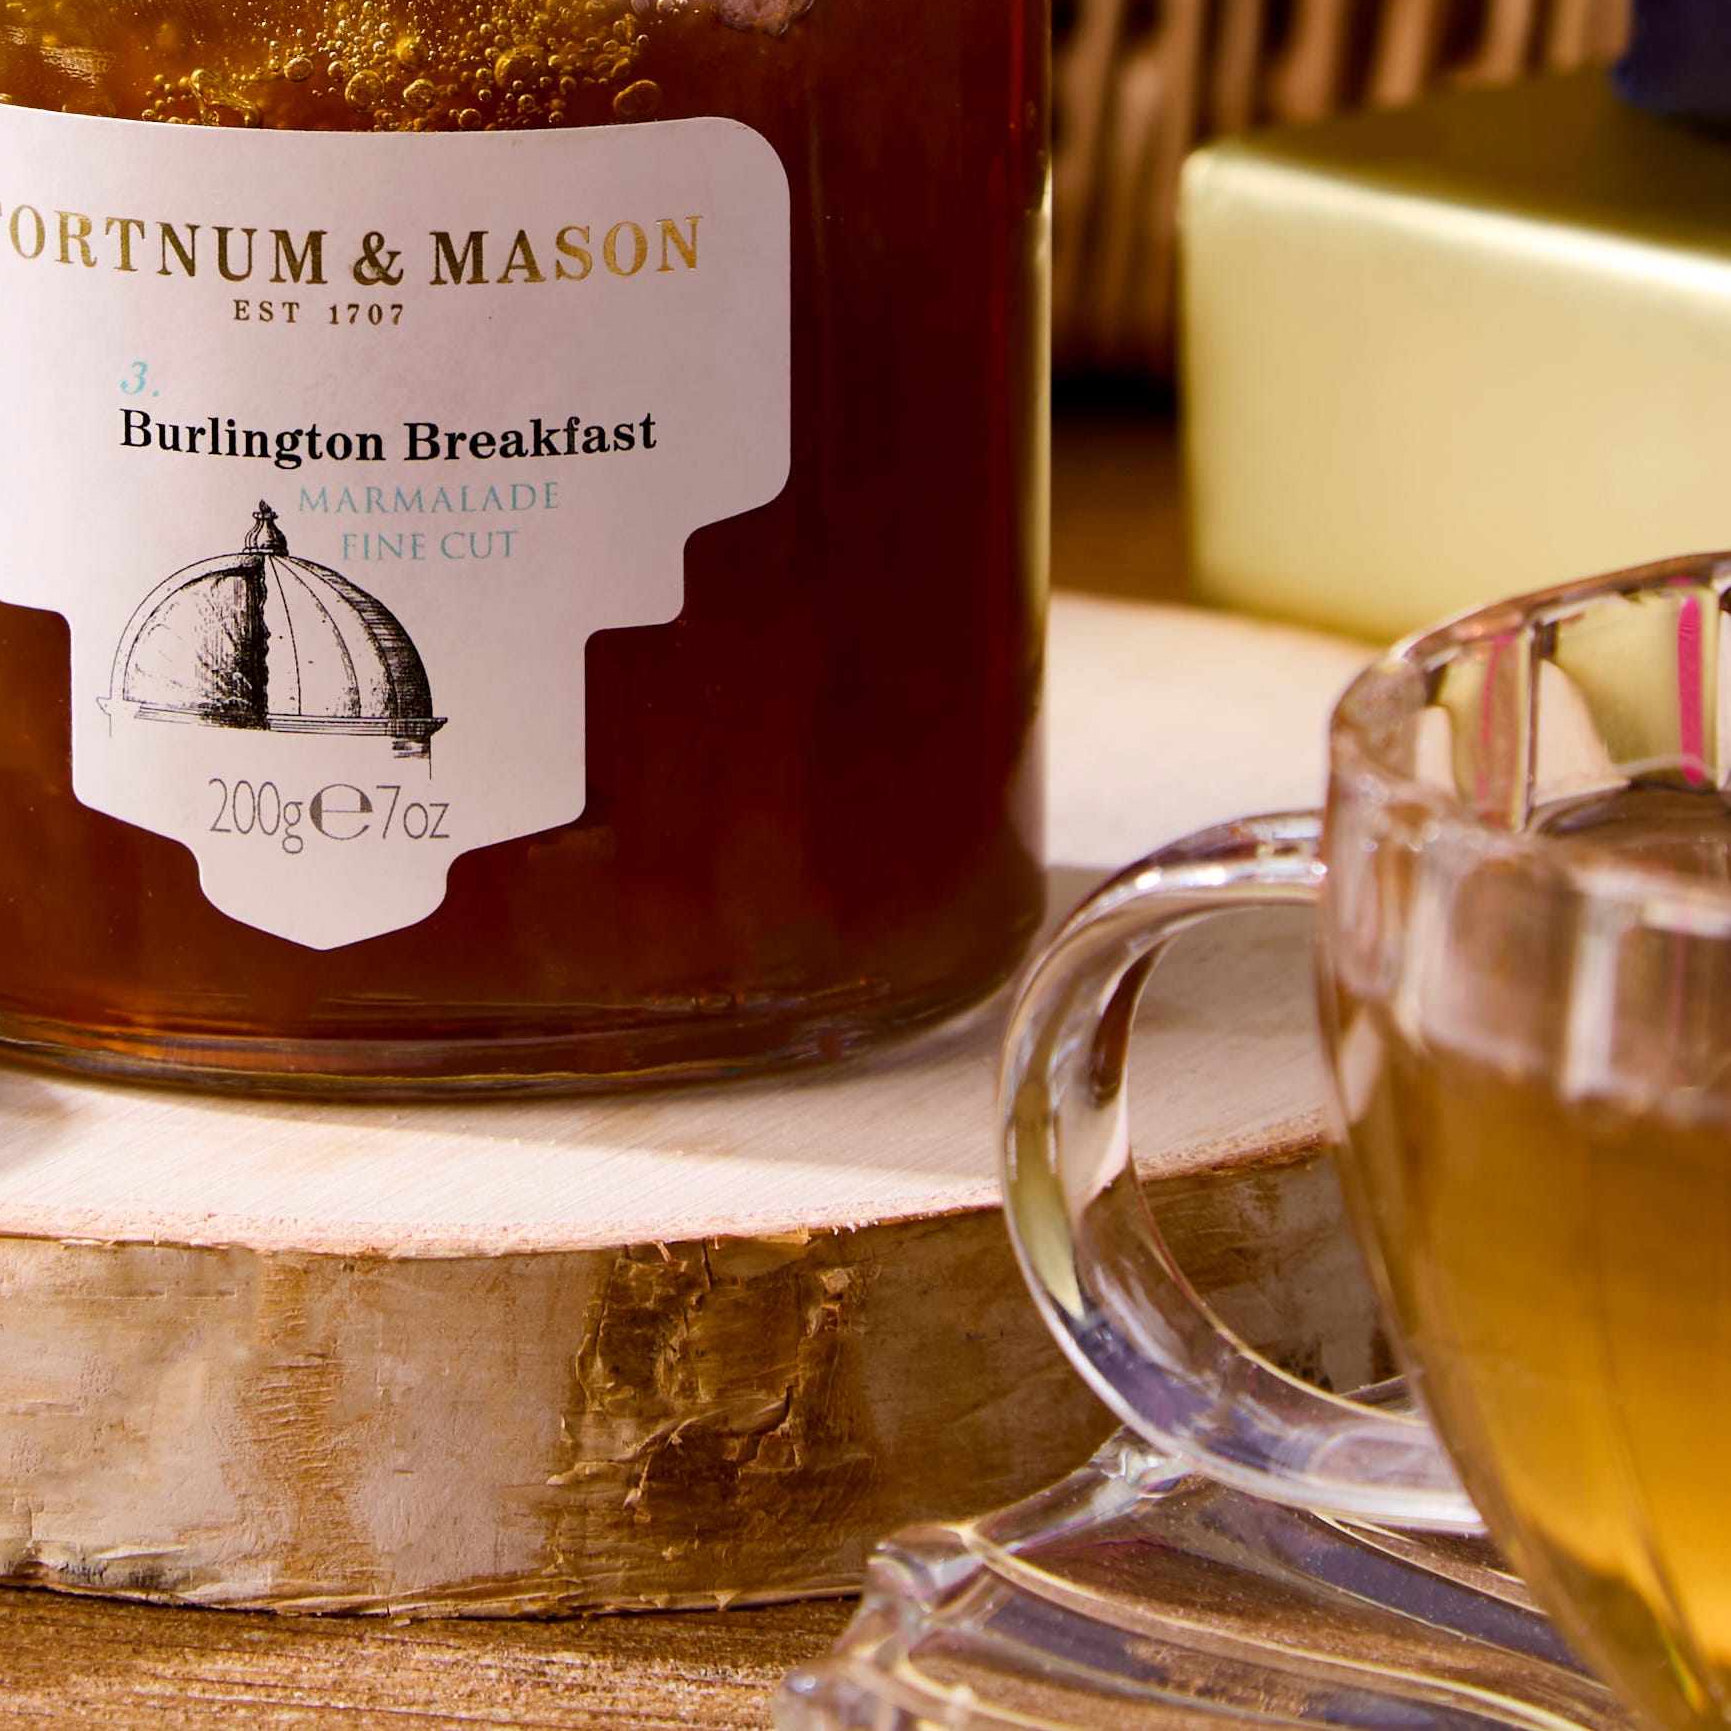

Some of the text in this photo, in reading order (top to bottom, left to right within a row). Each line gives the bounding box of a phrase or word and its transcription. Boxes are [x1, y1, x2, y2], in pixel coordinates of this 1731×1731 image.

[349, 231, 405, 287] &
[429, 216, 703, 285] MASON
[232, 299, 405, 326] EST 1707
[119, 361, 160, 397] 3.
[119, 408, 658, 470] Burlington Breakfast
[298, 480, 560, 514] MARMALADE
[341, 530, 518, 561] FINE CUT
